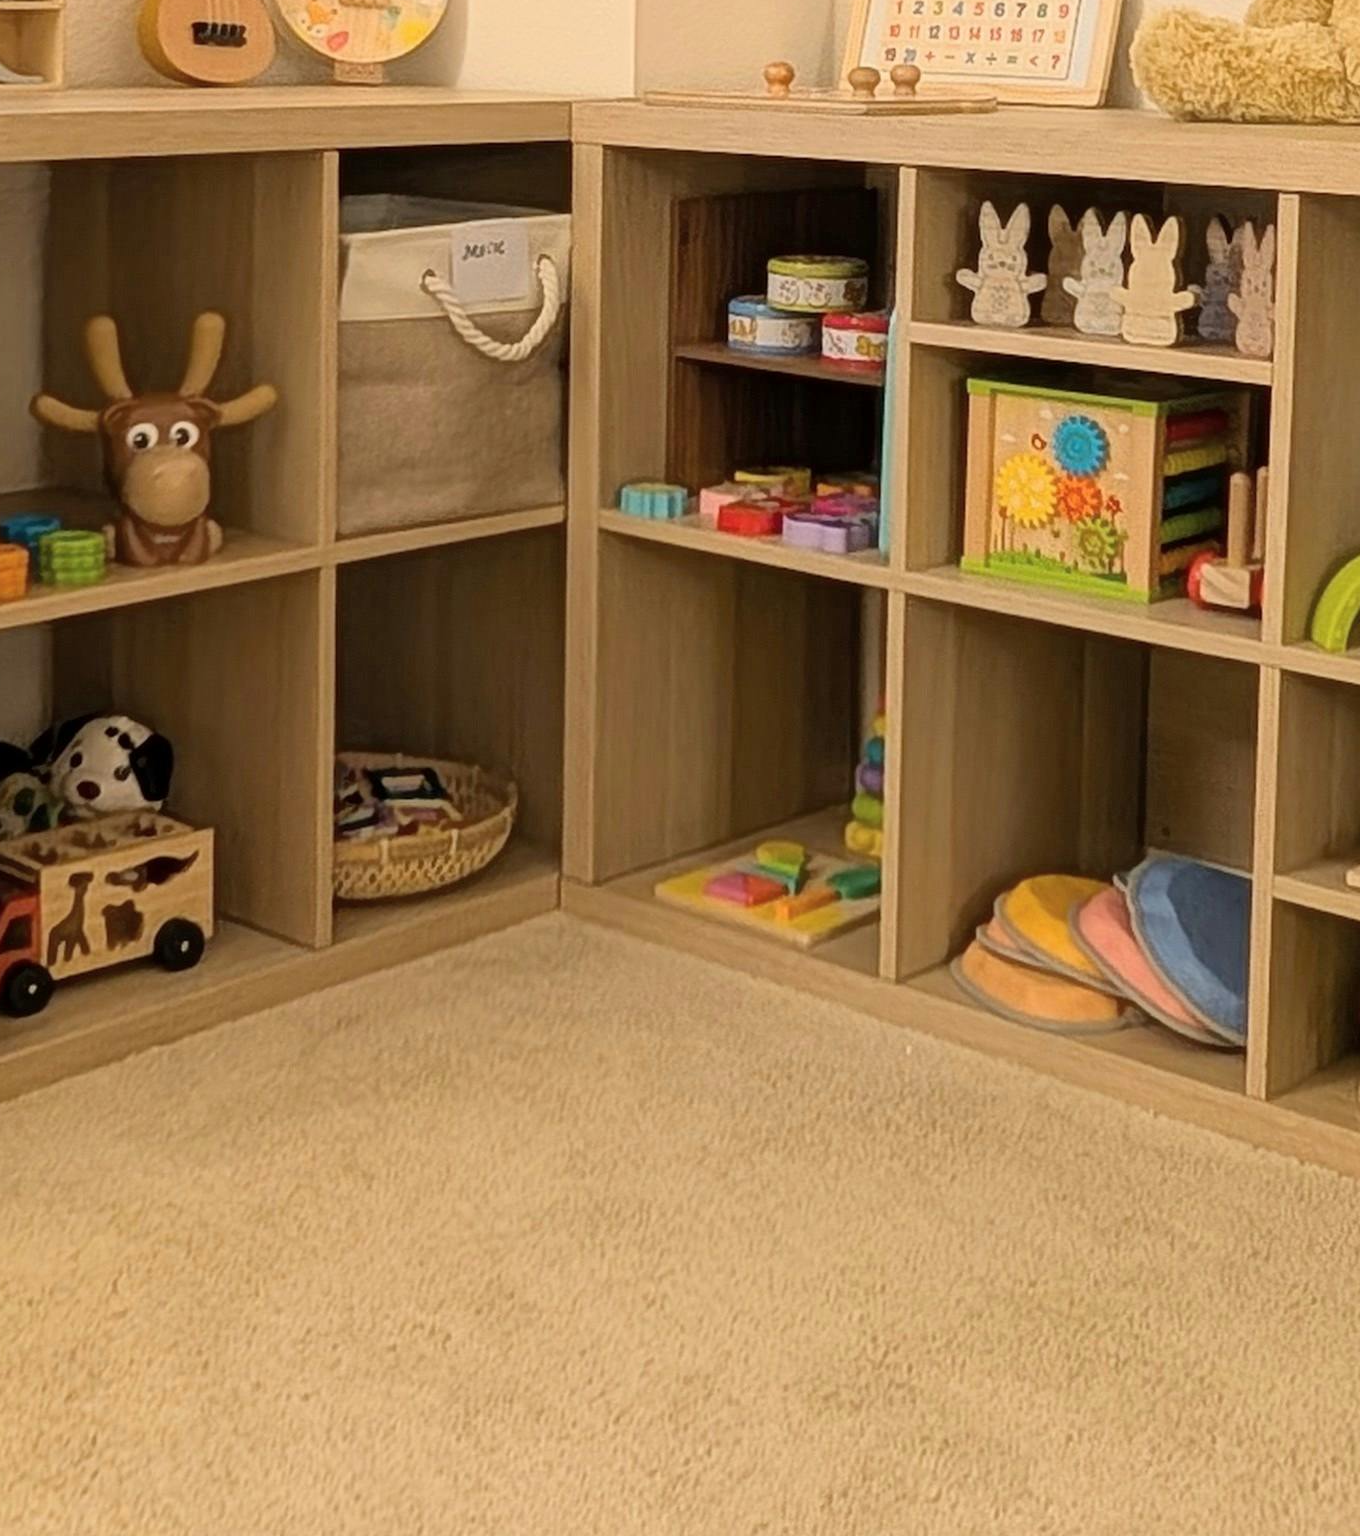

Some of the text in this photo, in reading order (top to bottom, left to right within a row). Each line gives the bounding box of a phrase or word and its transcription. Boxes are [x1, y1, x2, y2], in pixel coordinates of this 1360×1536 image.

[896, 0, 1070, 19] 1 2 3 4 5 6 7 8 9
[909, 24, 921, 39] 11
[928, 24, 941, 40] 12
[989, 26, 1002, 42] 15
[1031, 28, 1045, 44] 17
